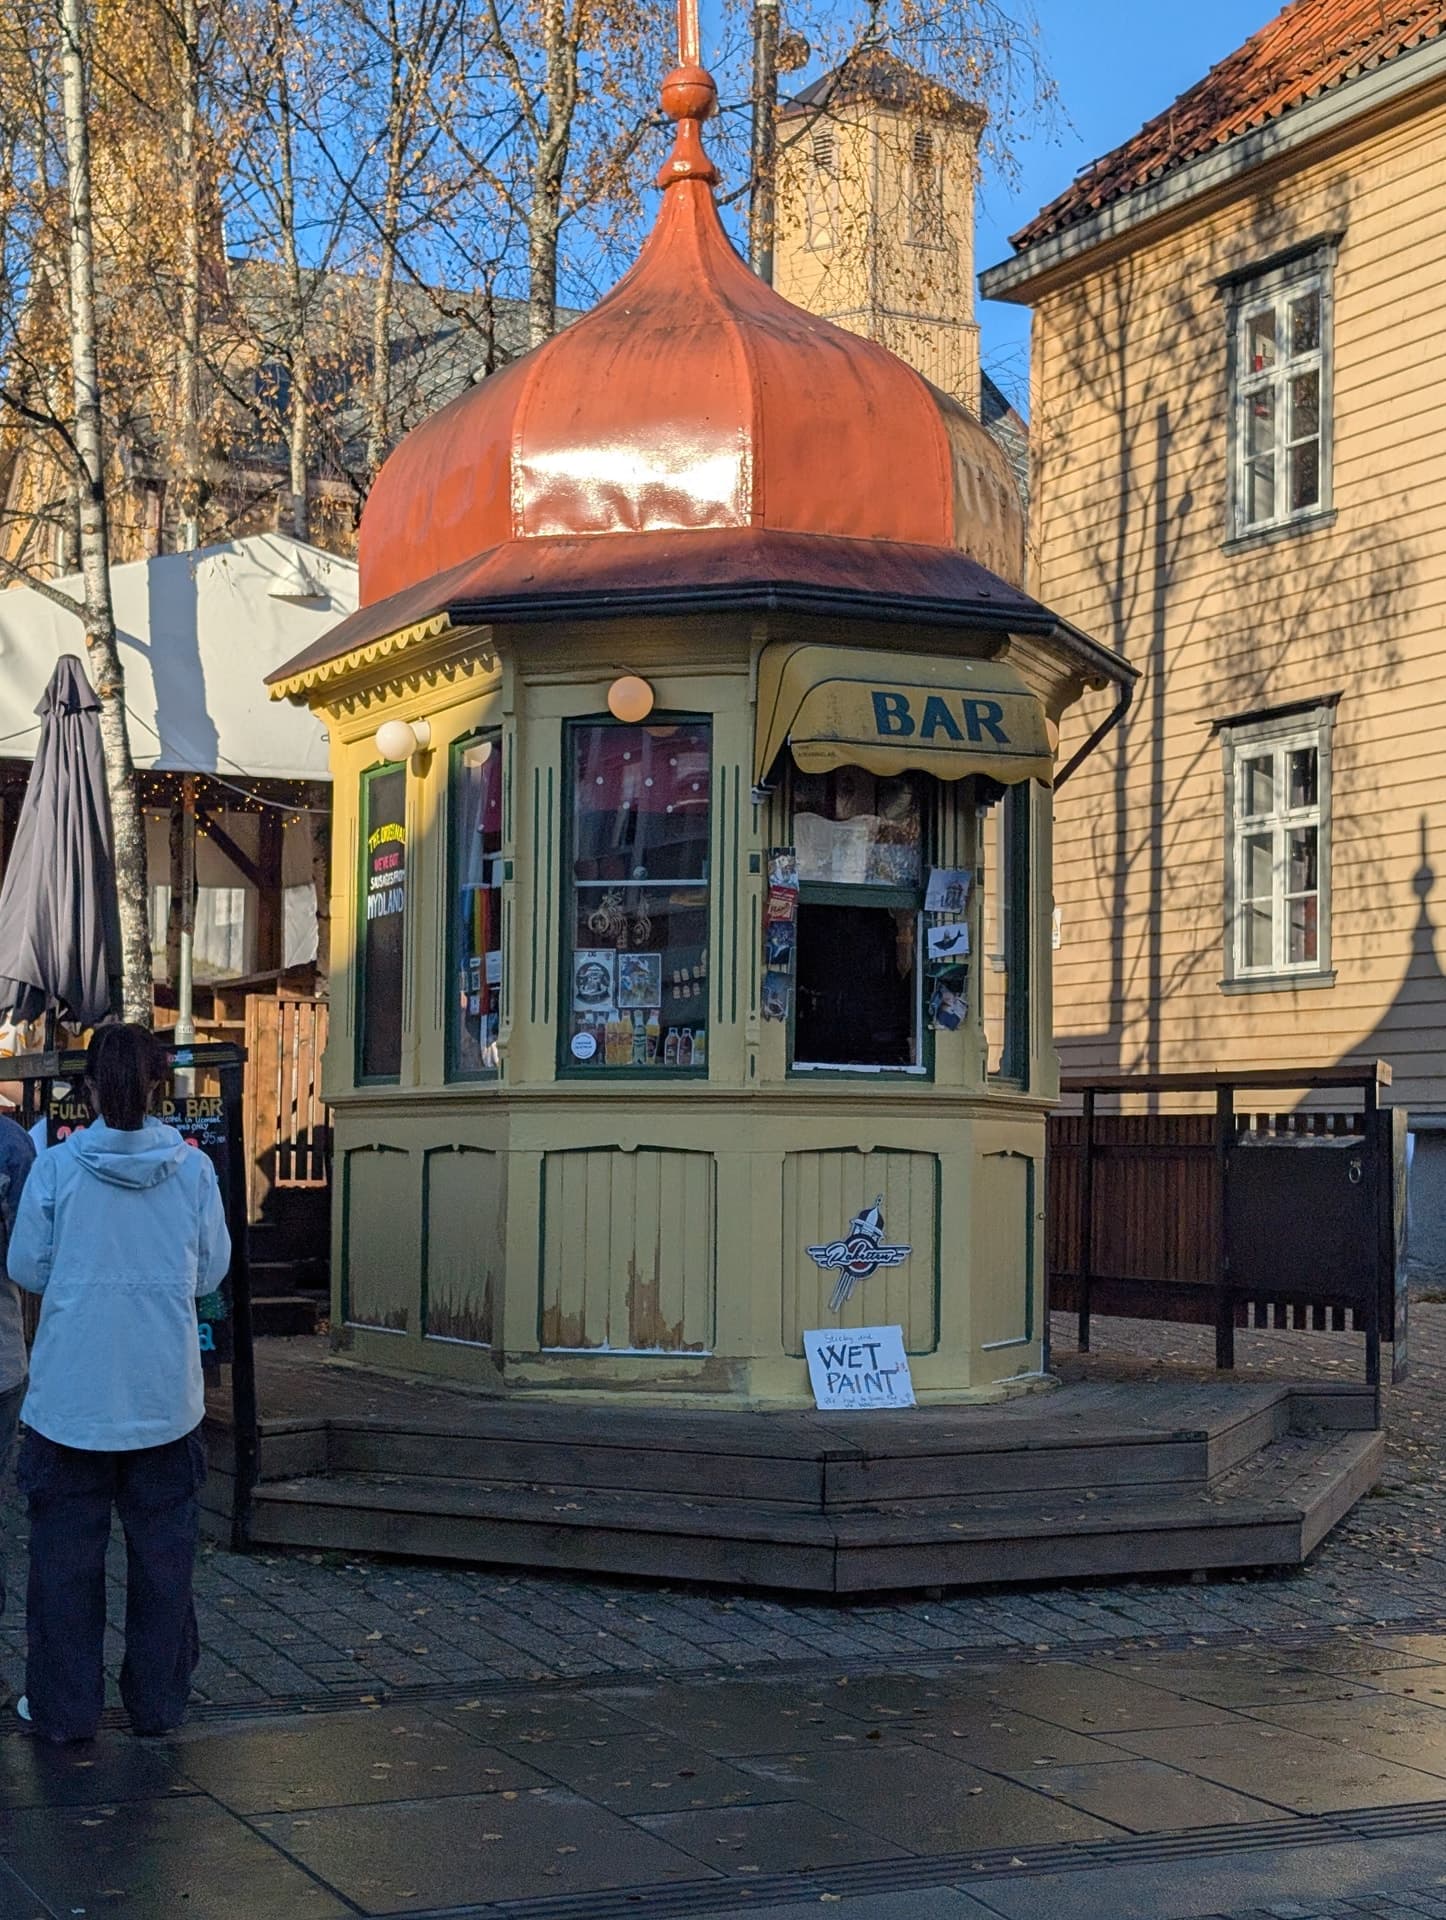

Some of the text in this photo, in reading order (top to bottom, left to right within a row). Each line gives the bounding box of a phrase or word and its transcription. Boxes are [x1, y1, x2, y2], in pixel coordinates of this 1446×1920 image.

[871, 691, 1012, 744] BAR
[368, 827, 381, 854] THE
[370, 872, 393, 890] SAUSAGES
[367, 887, 404, 920] MYDLAND
[186, 1097, 224, 1118] BAR
[817, 1342, 881, 1371] WET
